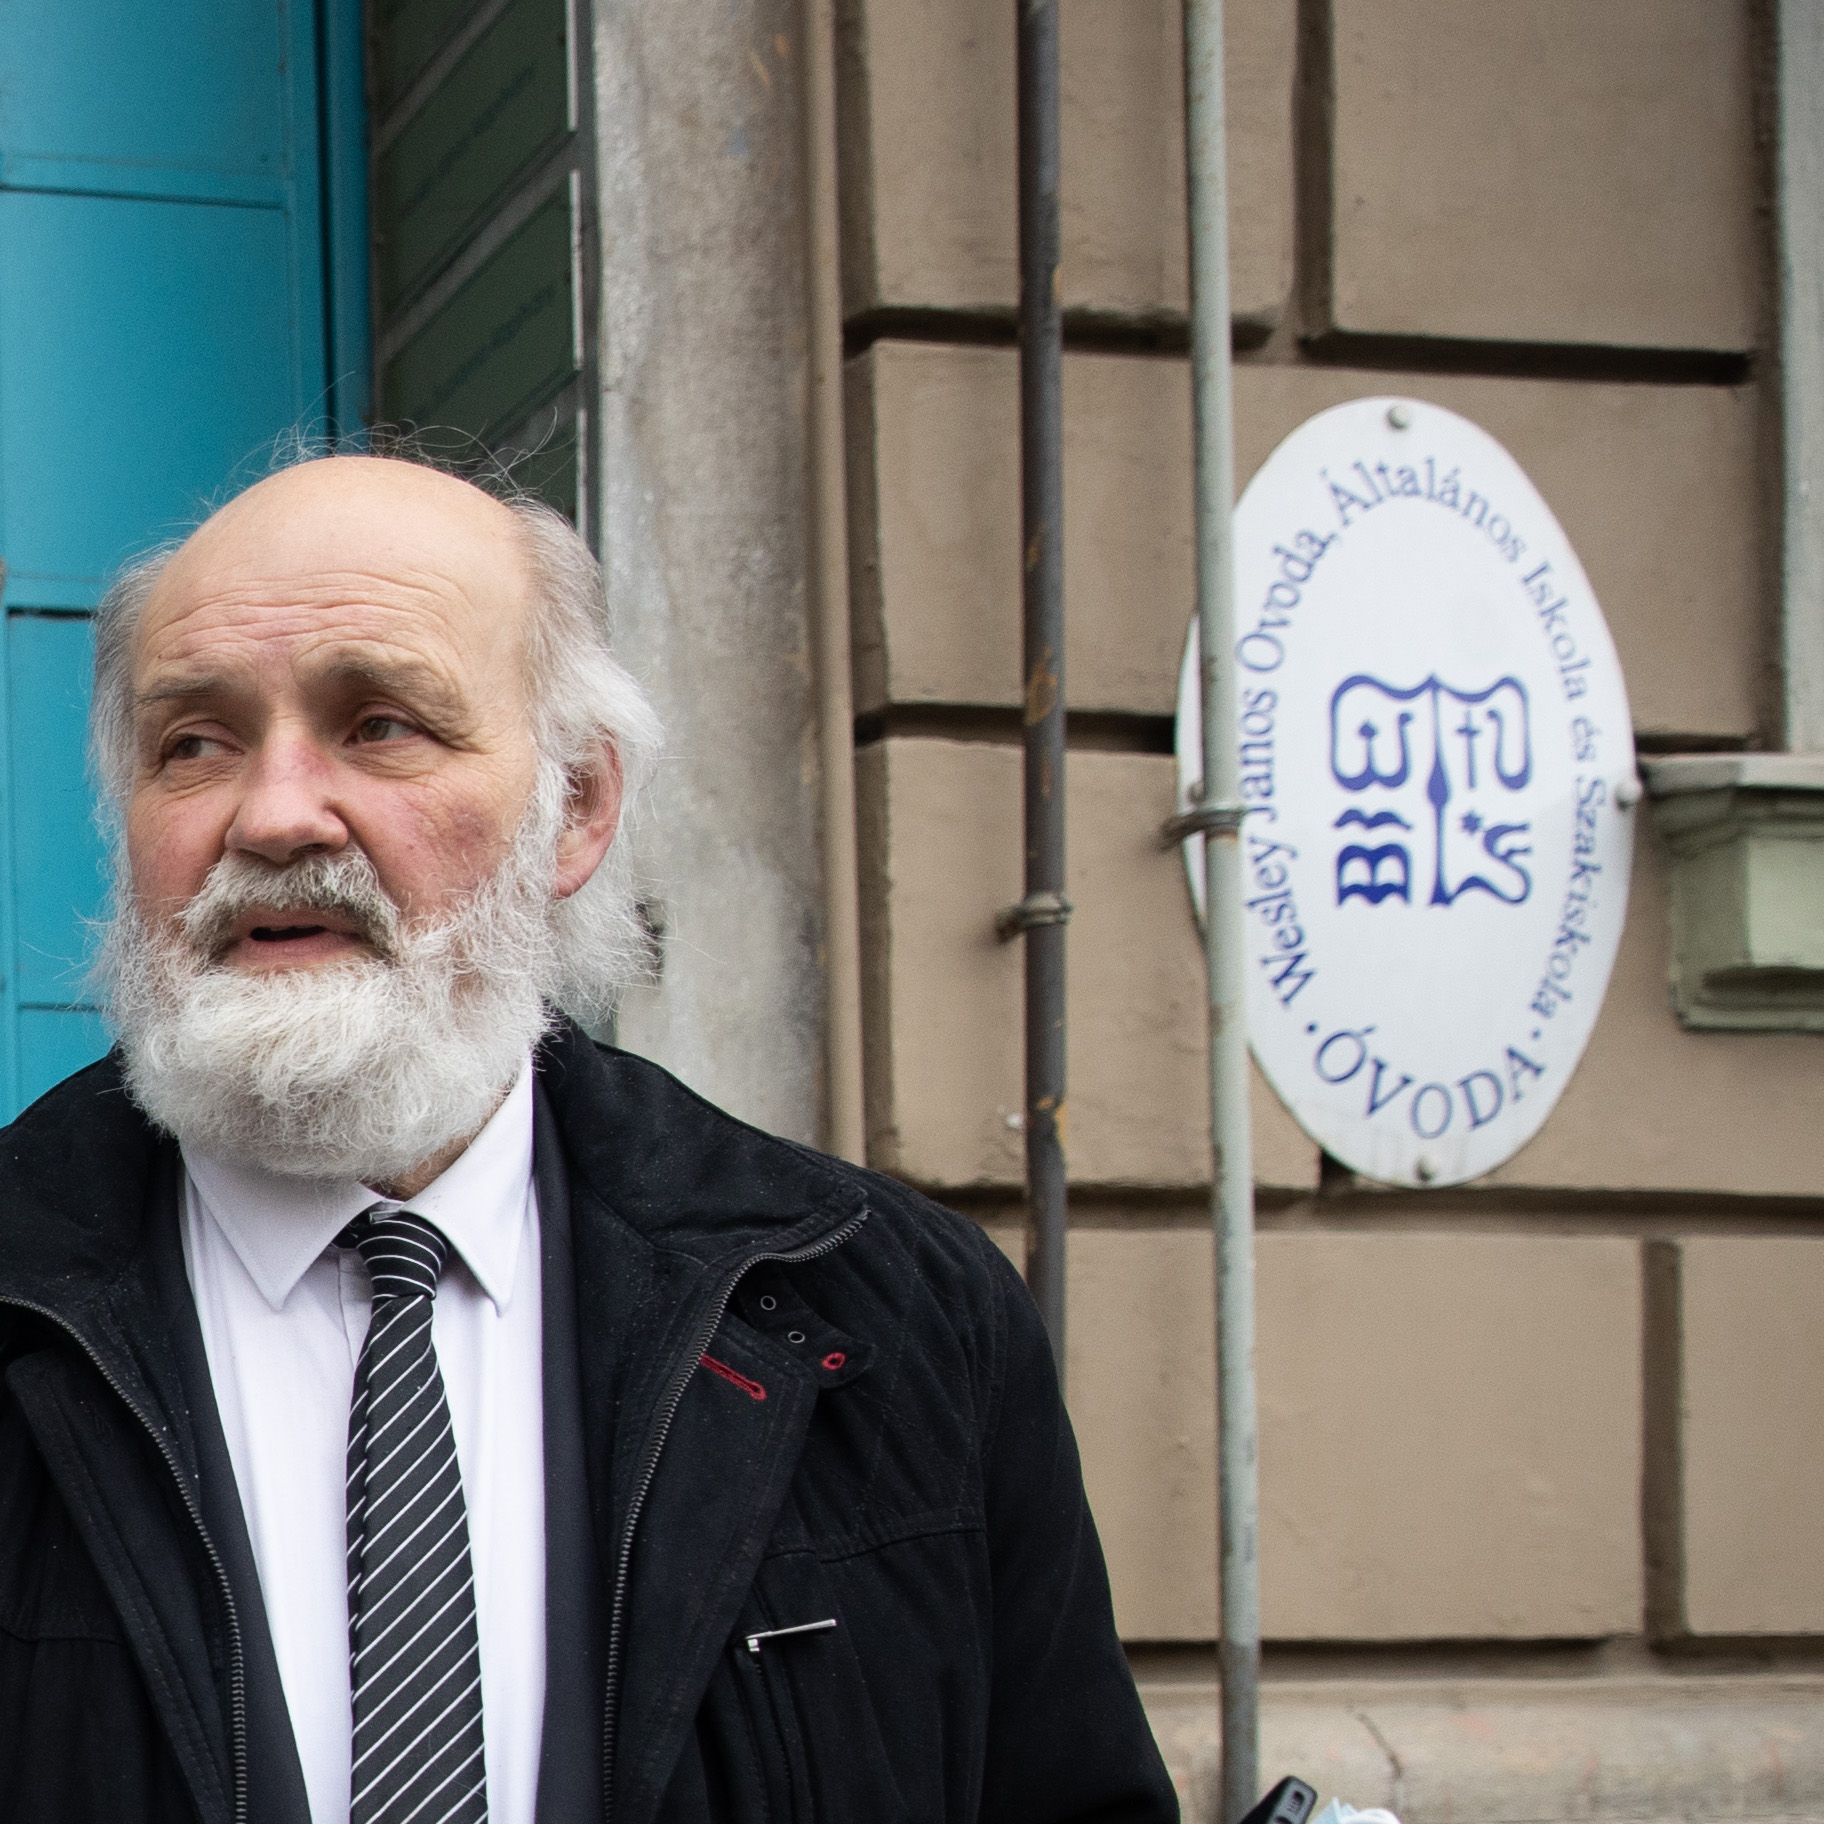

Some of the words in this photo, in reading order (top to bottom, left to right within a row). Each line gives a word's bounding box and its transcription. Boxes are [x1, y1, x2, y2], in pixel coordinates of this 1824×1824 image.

[1320, 457, 1526, 563] Általános
[1521, 561, 1592, 702] Iskola
[1569, 716, 1602, 763] és
[1245, 834, 1316, 1008] Wesley
[1529, 776, 1607, 1018] Szakiskola
[1314, 1024, 1546, 1140] ÓVODA
